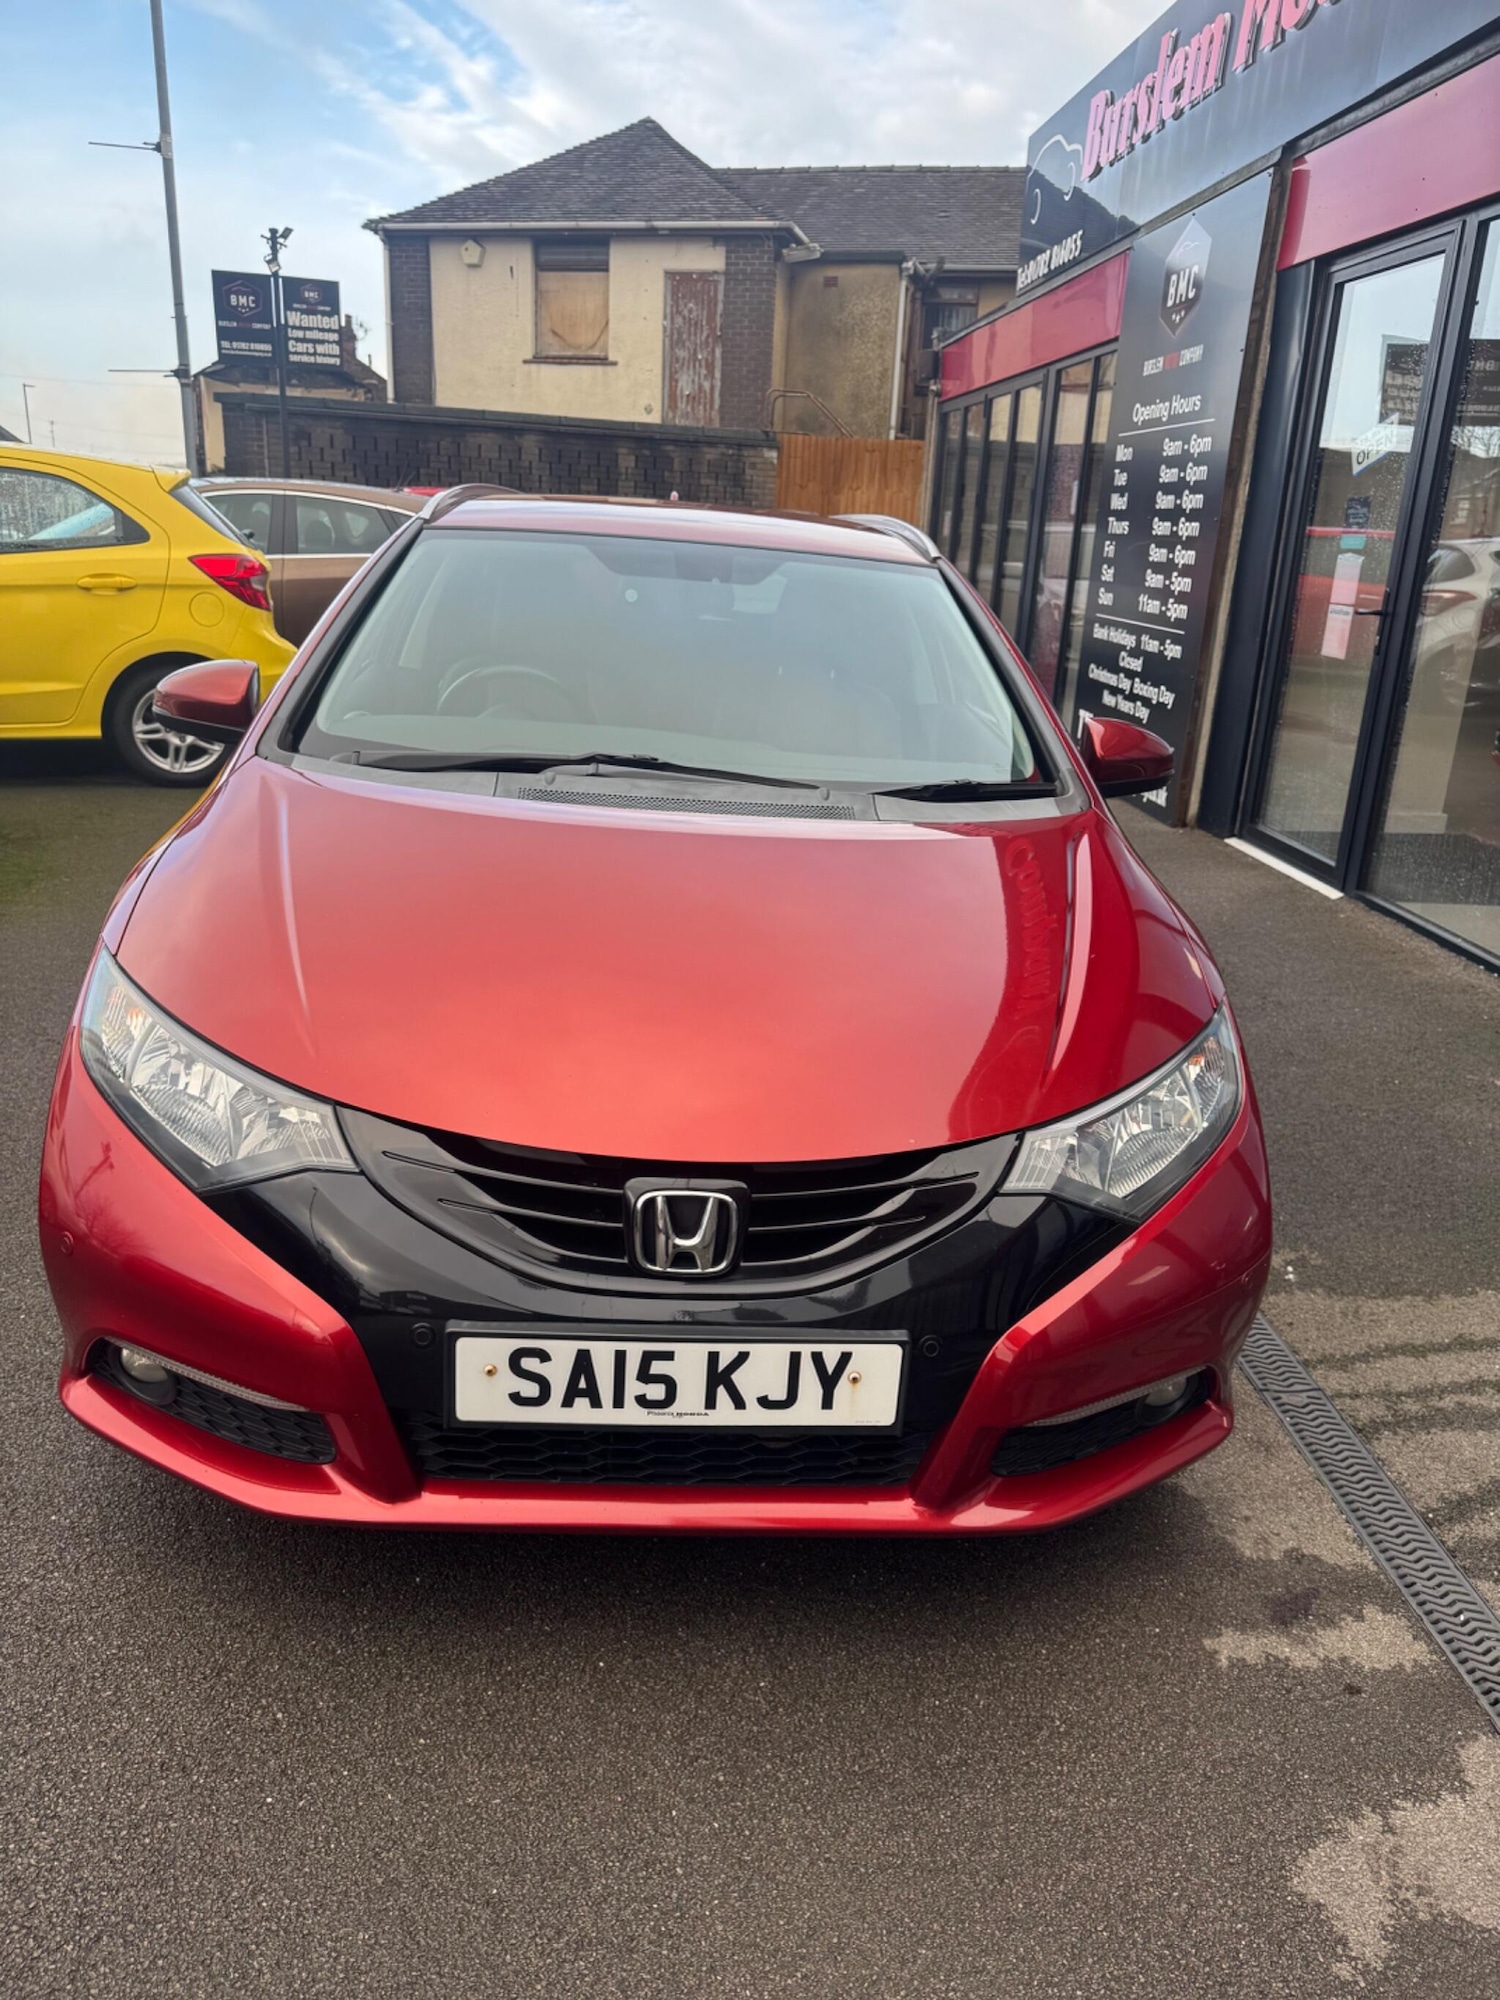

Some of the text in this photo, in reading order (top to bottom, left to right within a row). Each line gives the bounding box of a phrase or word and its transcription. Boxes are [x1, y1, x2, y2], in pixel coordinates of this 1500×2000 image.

[1082, 12, 1232, 183] Burslem
[1165, 264, 1200, 308] BMC
[230, 294, 256, 308] BMC
[286, 310, 340, 330] Wanted
[287, 328, 340, 342] Low mileage
[288, 339, 315, 354] Cars
[315, 342, 341, 356] with
[288, 353, 341, 367] service history
[1132, 394, 1202, 426] Opening Hours
[1115, 443, 1134, 462] Mon
[1162, 437, 1183, 457] 9am
[1189, 433, 1212, 459] 6pm
[1356, 430, 1394, 466] OPEN
[1113, 468, 1129, 487] Tue
[1158, 463, 1179, 484] 9am
[1185, 461, 1208, 486] 6pm
[1110, 492, 1129, 511] Wed
[1154, 490, 1176, 510] 9am
[1181, 488, 1204, 514] 6pm
[1107, 516, 1130, 536] Thurs
[1151, 516, 1172, 536] 9am
[1178, 516, 1200, 541] 6pm
[1103, 540, 1116, 558] Fri
[1148, 543, 1168, 563] 9am
[1174, 544, 1196, 569] 6pm
[1101, 563, 1115, 583] Sat
[1144, 568, 1165, 589] 9am
[1170, 571, 1192, 596] 5pm
[1097, 587, 1114, 607] Sun
[1137, 593, 1161, 616] 11am
[1166, 597, 1189, 623] 5pm
[1093, 622, 1109, 641] Bank
[1108, 627, 1137, 651] Holidays
[1140, 633, 1160, 654] 11am
[1164, 639, 1183, 661] 5pm
[1118, 650, 1144, 673] Closed
[1087, 662, 1176, 710] Christmas Day Boxing Day
[1102, 689, 1151, 725] New Years Day
[507, 1346, 854, 1411] SA15 KJY
